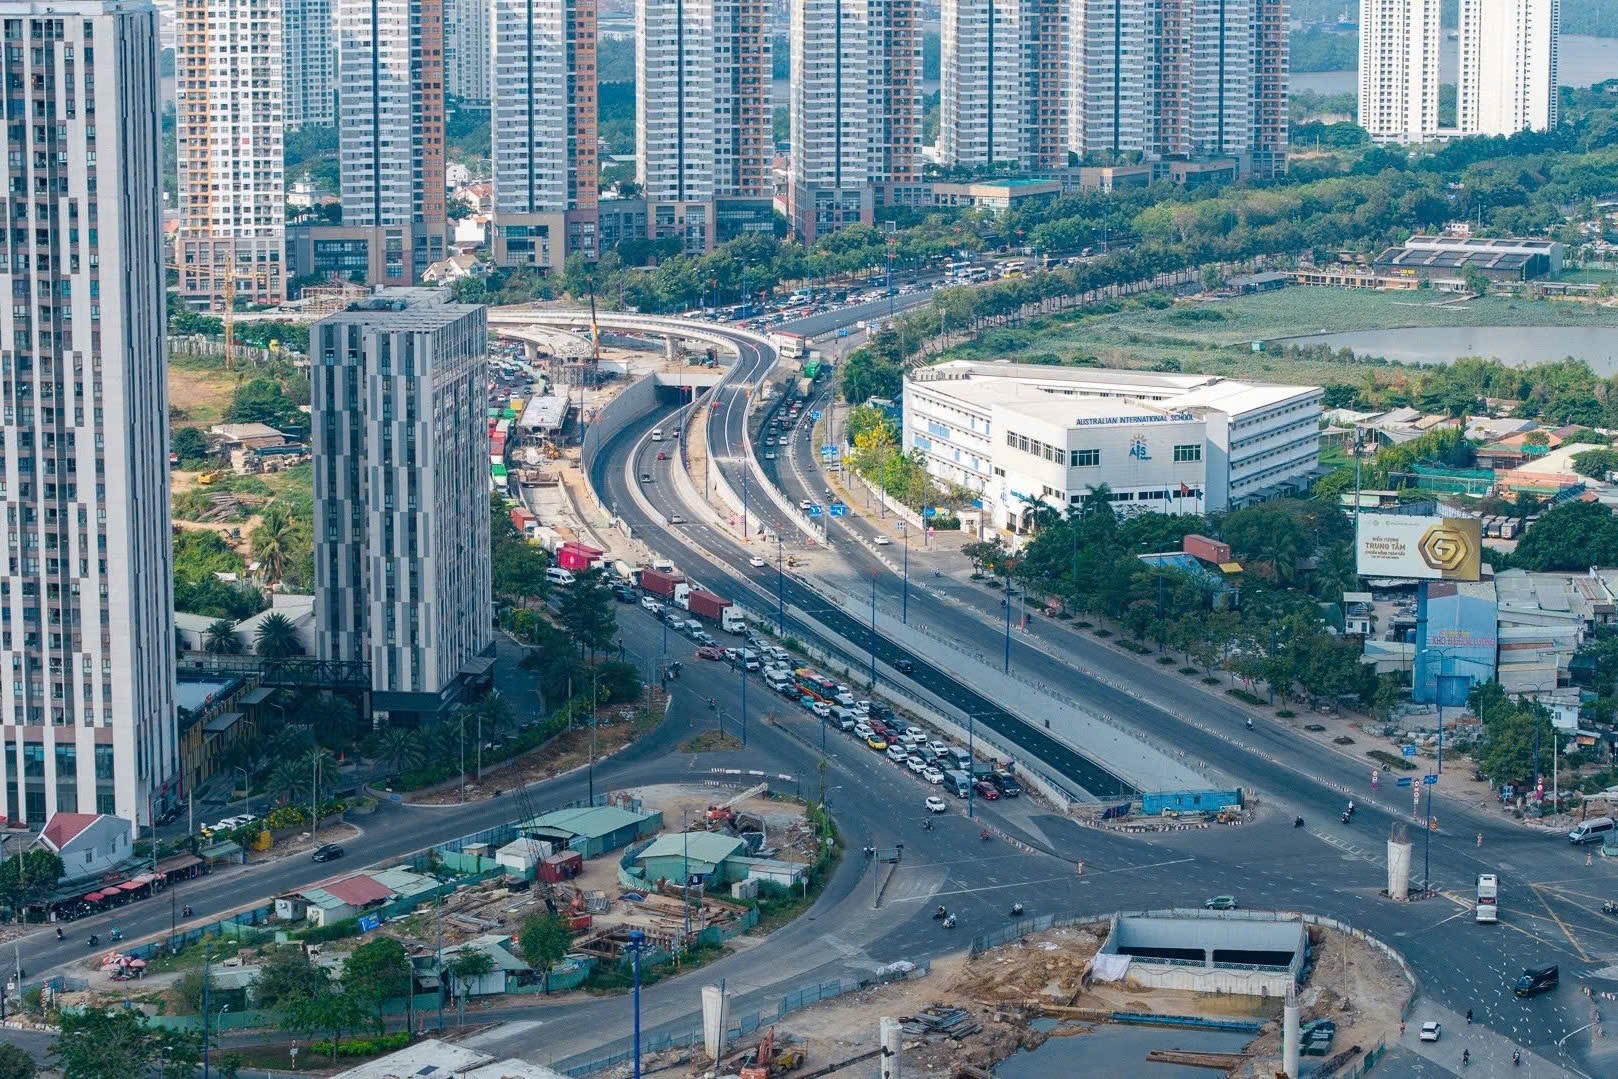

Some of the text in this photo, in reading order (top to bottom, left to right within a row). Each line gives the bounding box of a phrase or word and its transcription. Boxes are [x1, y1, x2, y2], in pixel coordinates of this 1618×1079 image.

[1076, 413, 1194, 426] AUSTRALIAN INTERNATIONAL SCHOOL
[1365, 542, 1390, 550] TRUNG
